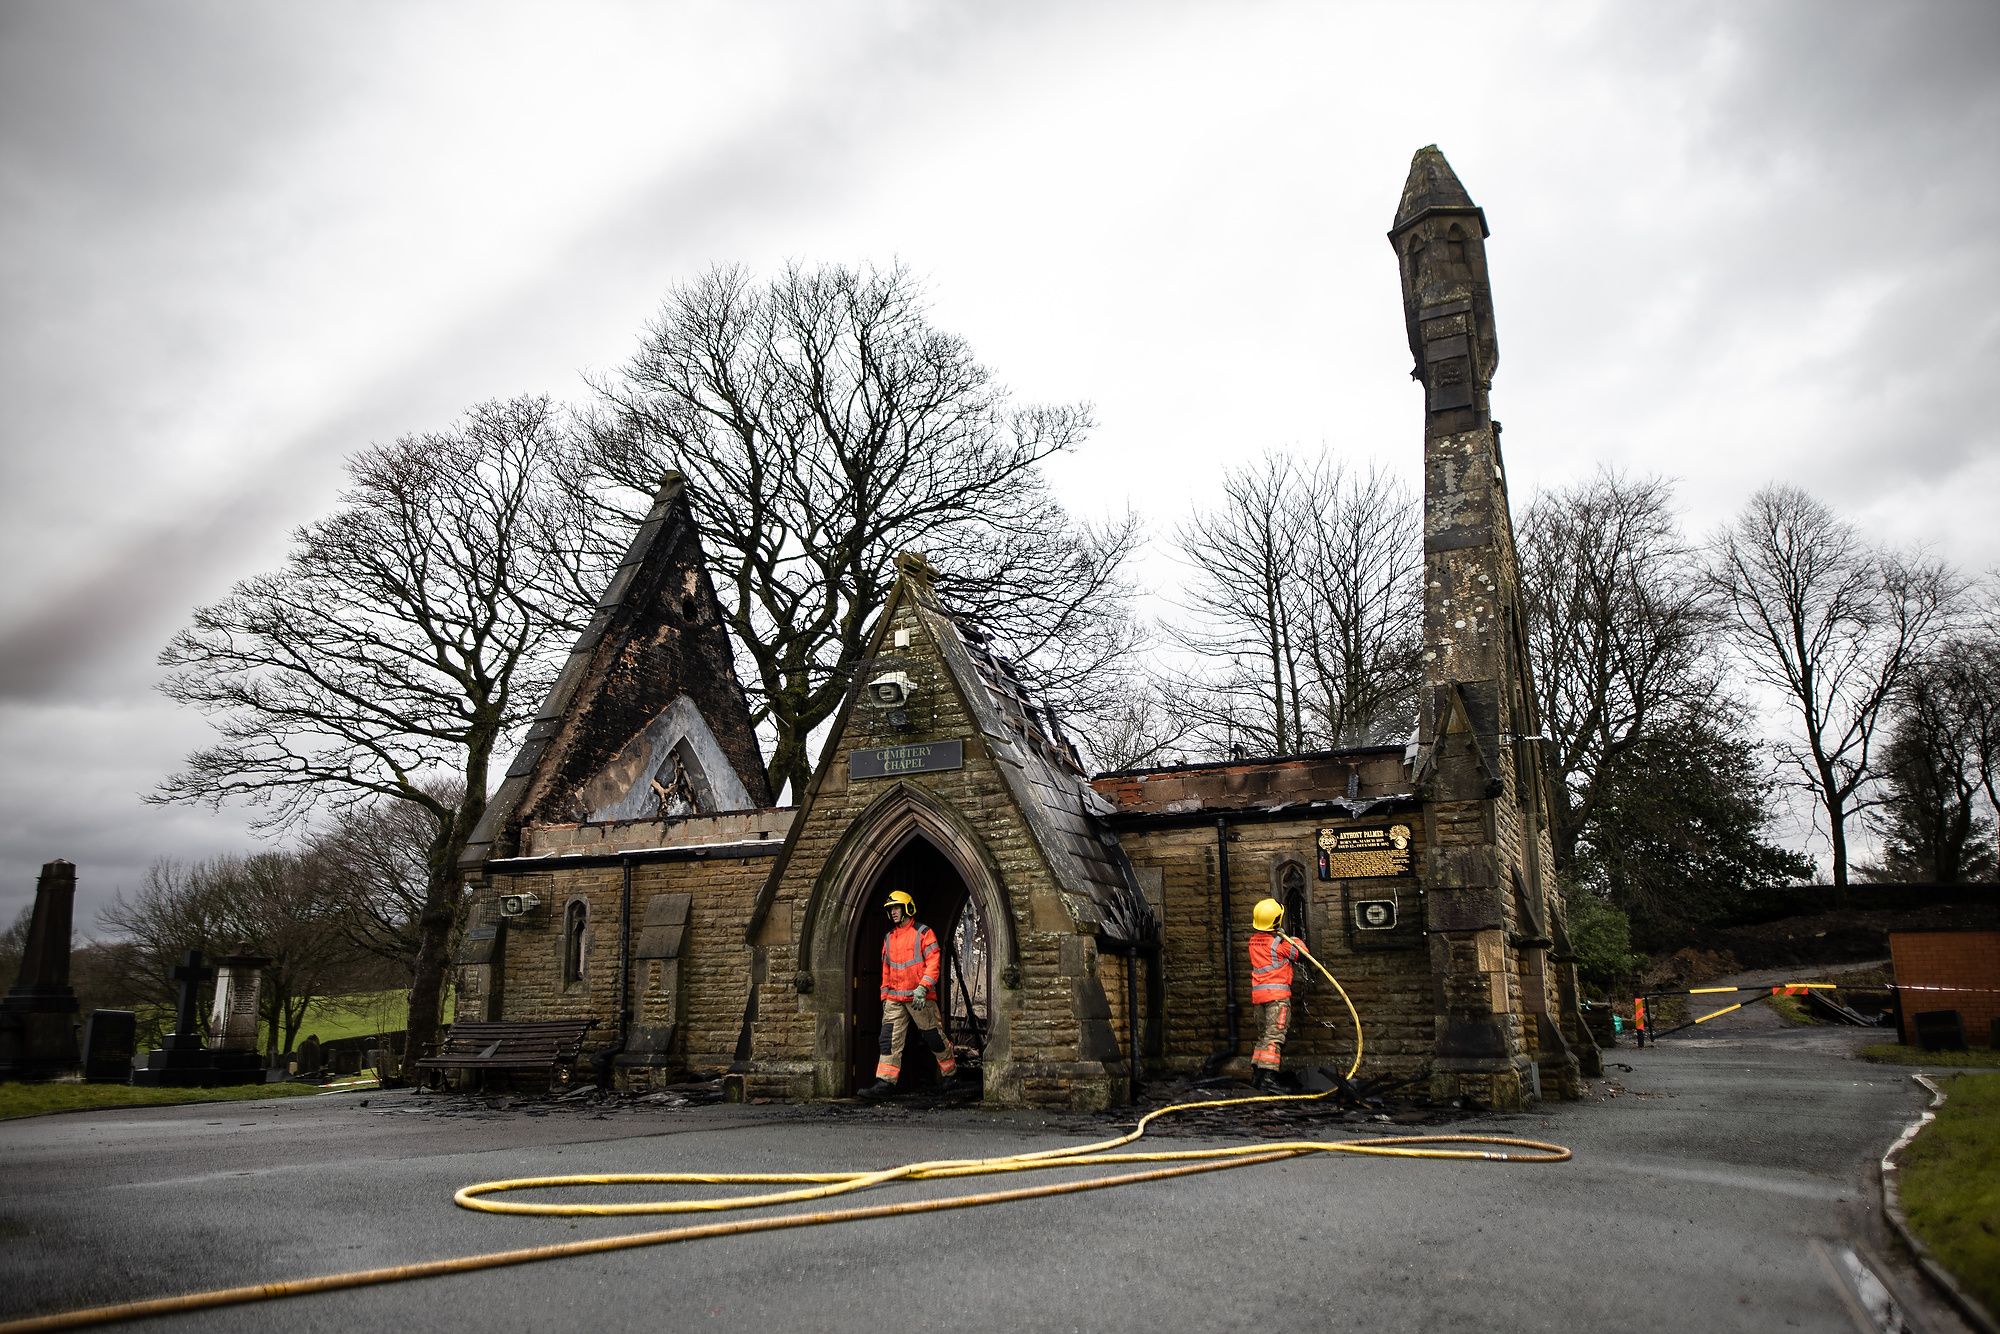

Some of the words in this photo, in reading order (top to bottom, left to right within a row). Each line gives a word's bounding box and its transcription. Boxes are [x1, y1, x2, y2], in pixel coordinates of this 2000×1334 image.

[876, 746, 933, 760] CEMETERY
[884, 758, 925, 771] CHAPEL
[1363, 830, 1384, 838] PALMER
